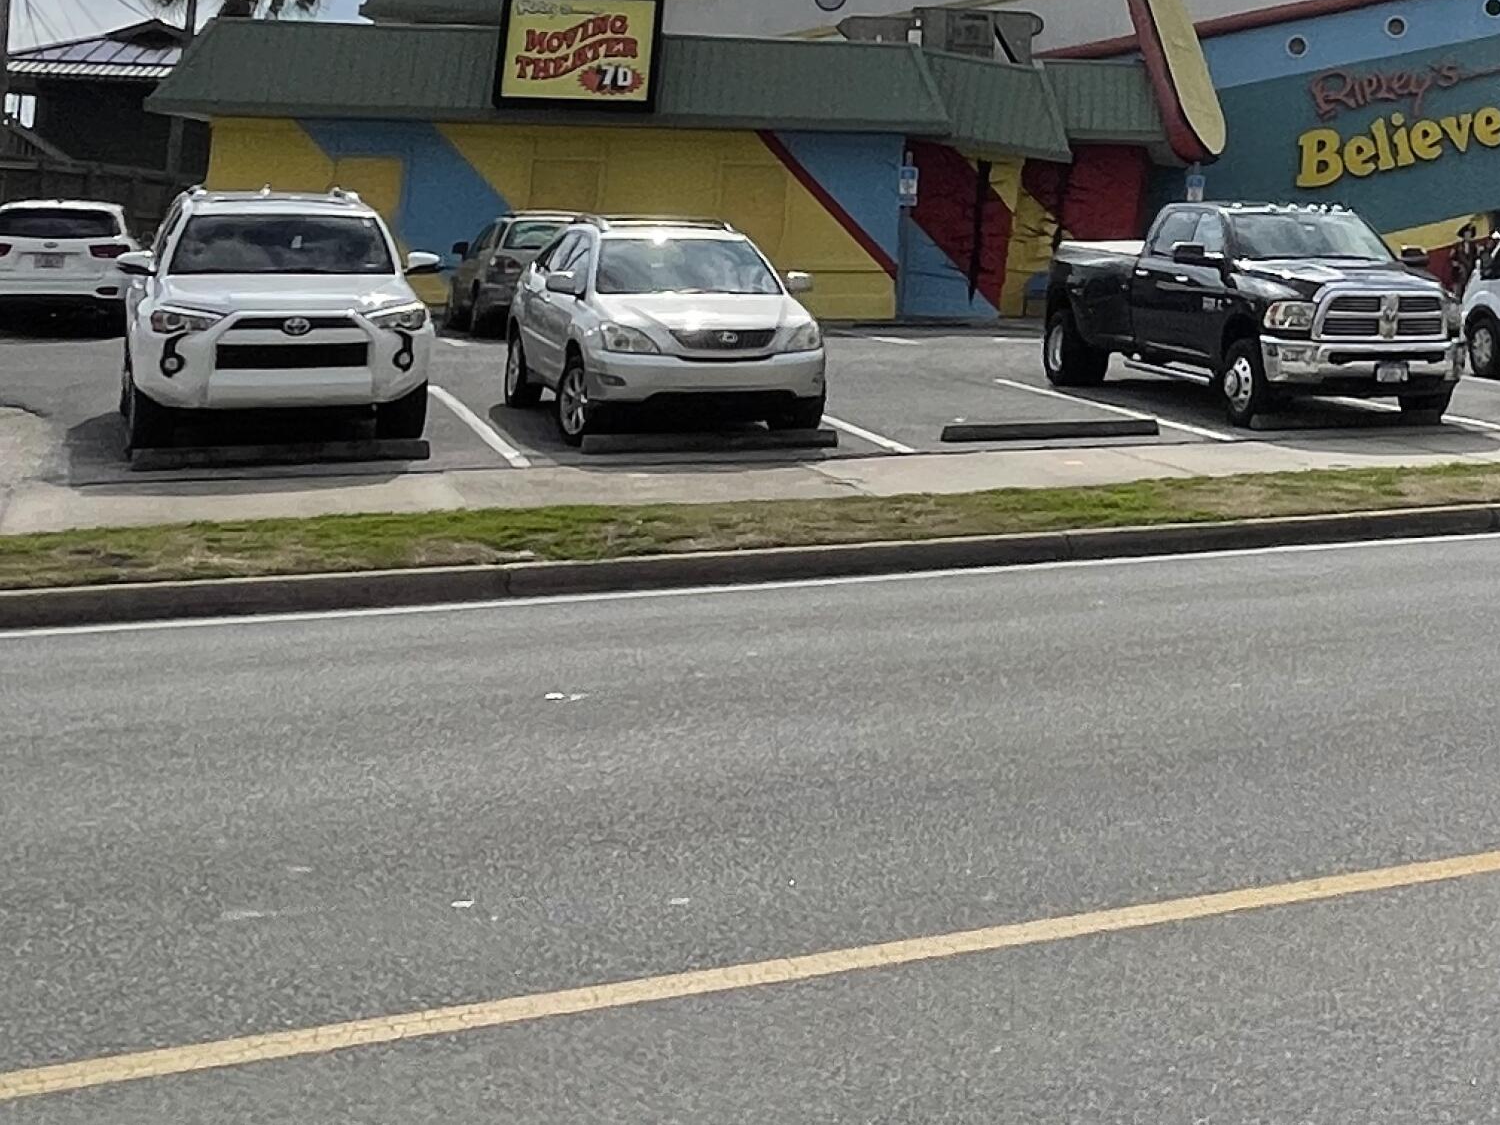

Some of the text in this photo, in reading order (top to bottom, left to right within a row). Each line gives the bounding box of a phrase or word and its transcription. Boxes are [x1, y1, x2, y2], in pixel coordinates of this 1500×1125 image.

[523, 14, 629, 54] MOVING
[515, 37, 639, 80] THEATER
[599, 64, 634, 88] 7D
